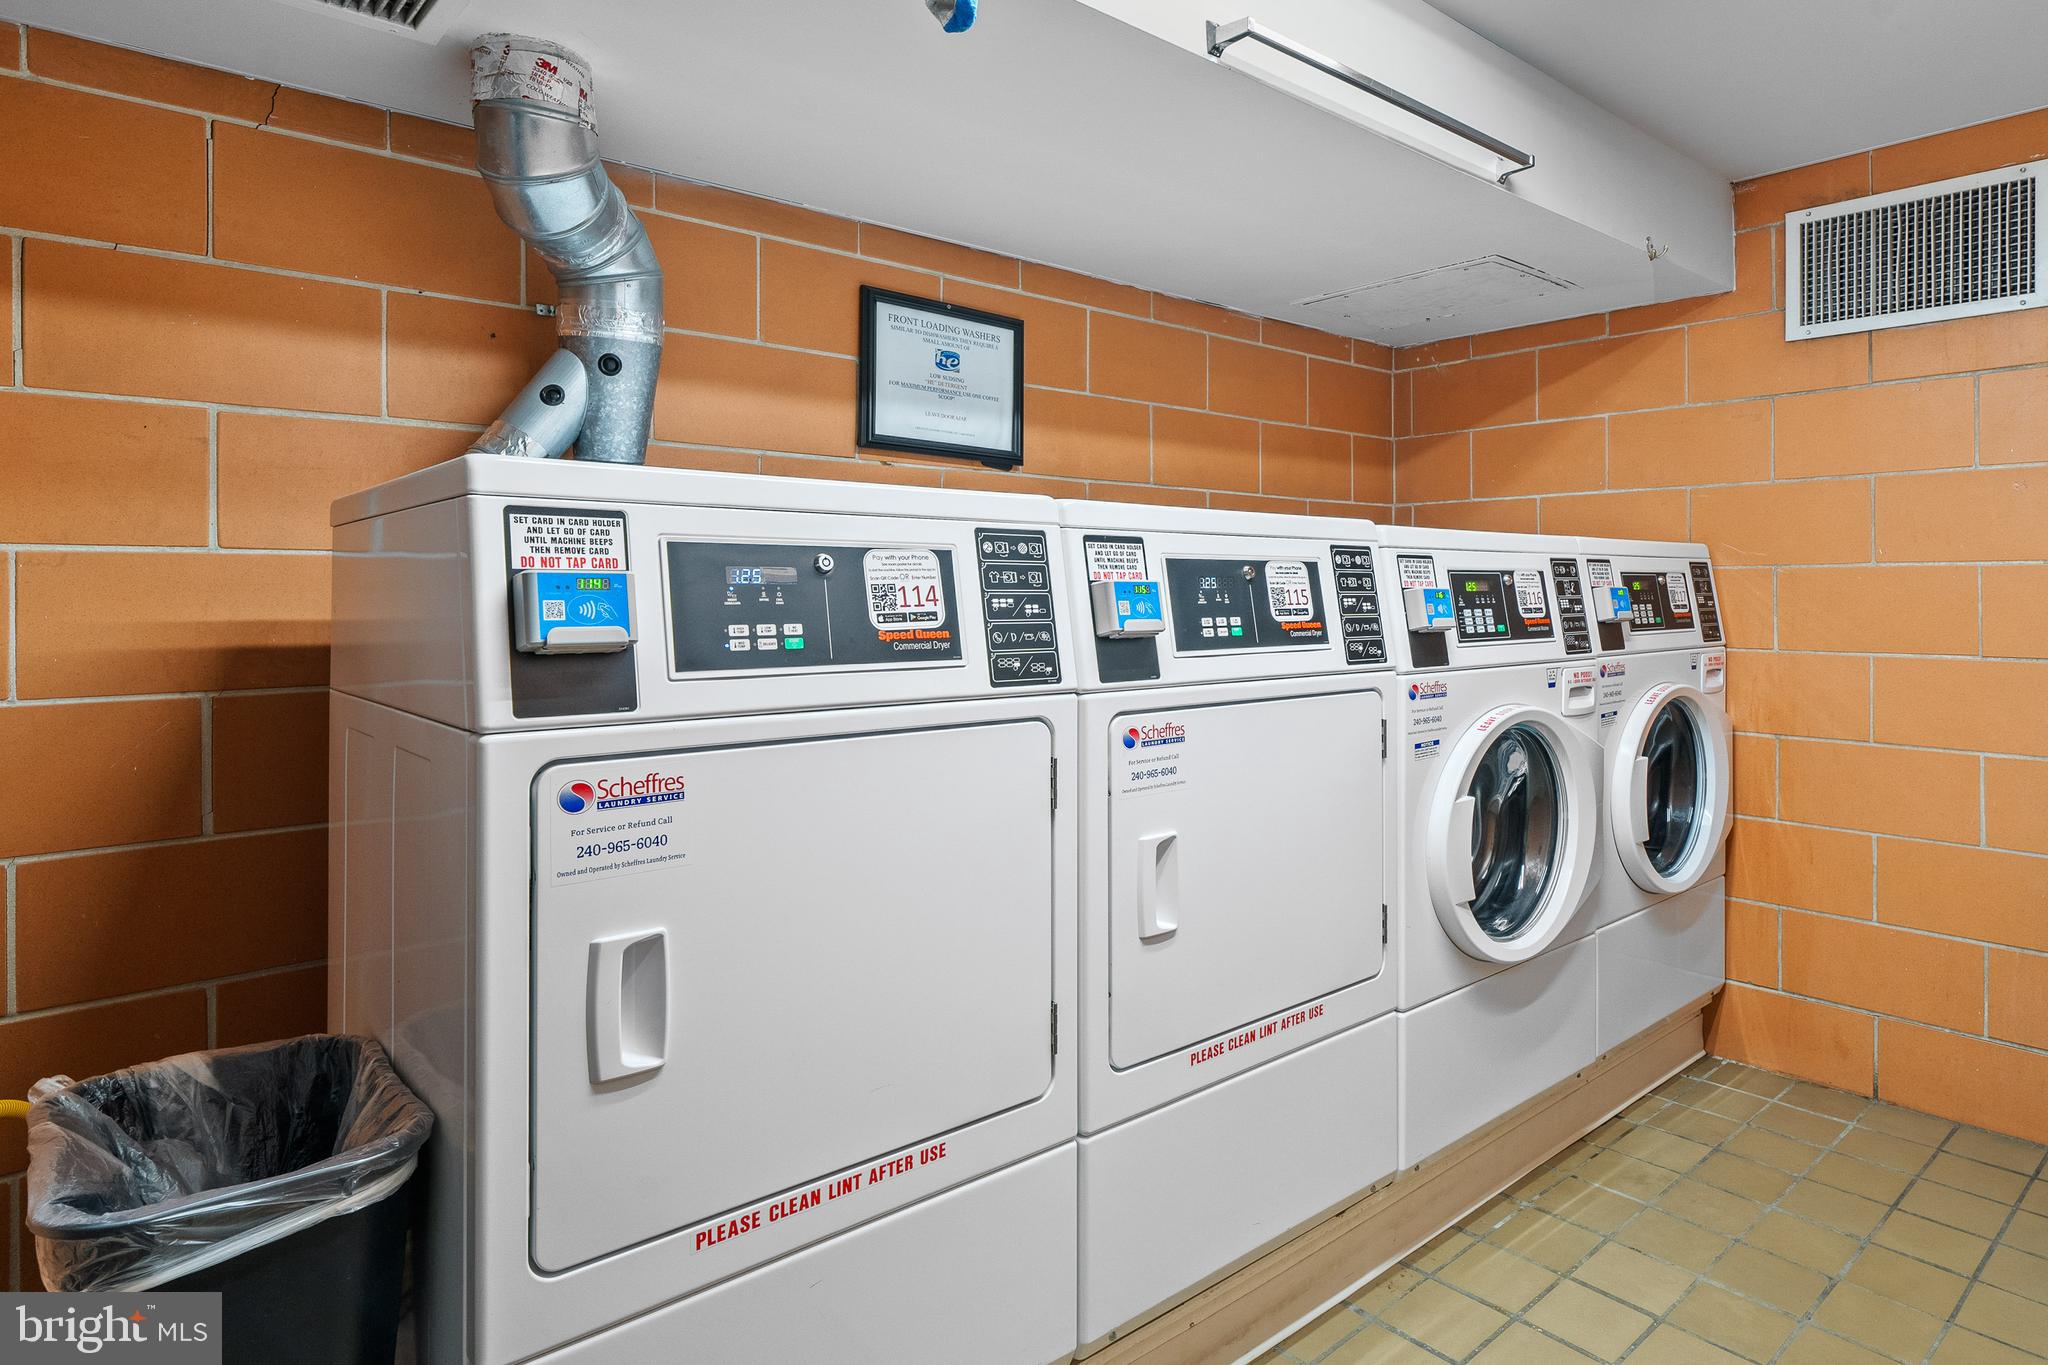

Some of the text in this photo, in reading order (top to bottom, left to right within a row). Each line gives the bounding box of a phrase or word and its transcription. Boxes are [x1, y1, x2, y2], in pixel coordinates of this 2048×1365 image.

[535, 57, 558, 75] 3M
[888, 313, 1001, 344] FRONT LOADING WASHERS
[513, 516, 529, 524] SET
[532, 517, 554, 525] CARD
[568, 518, 589, 526] CARD
[527, 526, 543, 534] AND
[547, 527, 561, 535] LET
[524, 536, 613, 546] UNTIL MACHINE BEEPS
[555, 546, 585, 554] REMOVE
[589, 547, 610, 555] CARD
[520, 556, 618, 569] DO NOT TAP CARD
[1103, 572, 1113, 580] NOT
[1116, 572, 1126, 580] TAP
[1128, 572, 1142, 580] CARD
[898, 585, 939, 608] 114
[1286, 589, 1309, 605] 115
[1528, 591, 1543, 605] 116
[1281, 622, 1302, 630] Speed
[878, 630, 950, 642] Speed Queen
[893, 641, 951, 650] Commercial Dryer
[1420, 680, 1447, 694] Scheffres
[1141, 722, 1185, 740] Scheffres
[1131, 766, 1177, 781] 240-965-6040
[597, 772, 684, 799] Scheffres
[598, 793, 684, 809] LAUNDRY SERVICE
[571, 829, 584, 837] For
[586, 824, 615, 835] Service
[628, 818, 656, 829] Refund
[657, 816, 673, 825] Call
[576, 834, 668, 858] 240-965-6040
[557, 869, 576, 878] Owned
[589, 865, 613, 874] Operated
[621, 859, 645, 868] Scheffres
[646, 856, 667, 864] Laundry
[668, 853, 686, 861] Service
[1190, 1004, 1324, 1066] PLEASE CLEAN LINT AFTER USE
[696, 1142, 946, 1251] PLEASE CLEAN LINT AFTER USE
